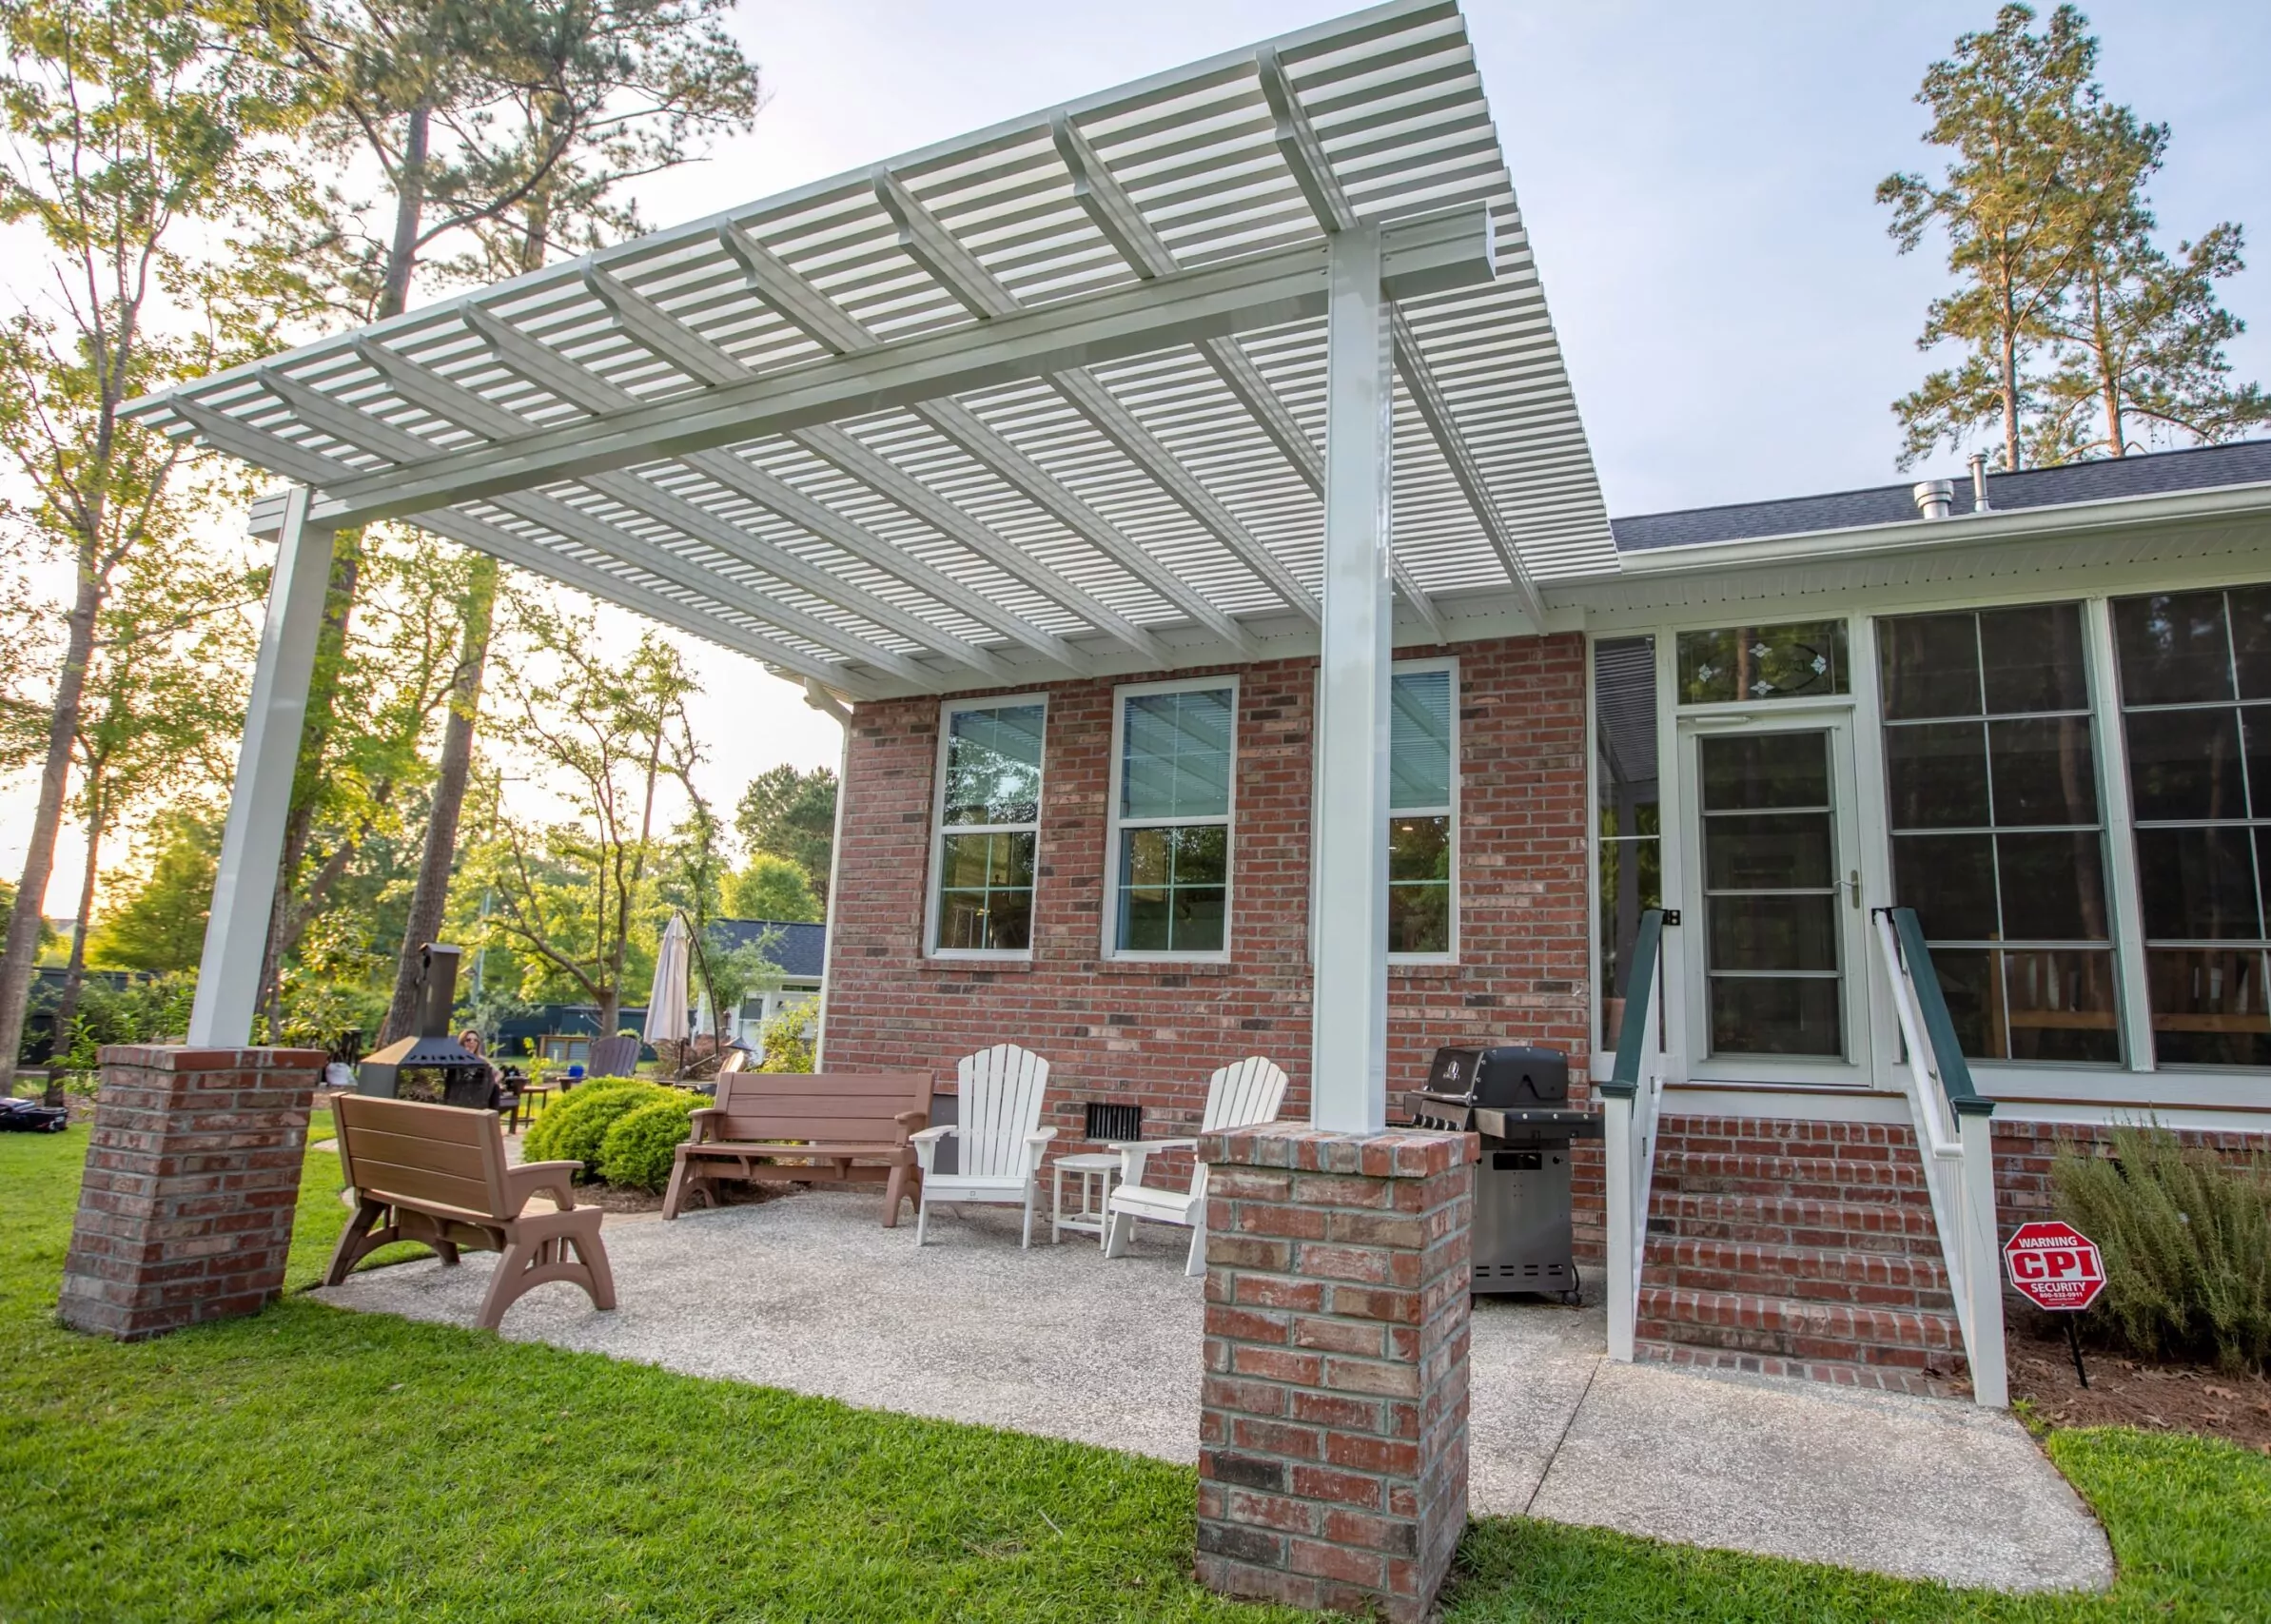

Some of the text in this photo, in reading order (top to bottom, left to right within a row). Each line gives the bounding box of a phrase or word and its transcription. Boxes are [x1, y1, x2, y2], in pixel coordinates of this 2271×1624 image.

[2018, 1237, 2078, 1248] WARNING
[2012, 1250, 2097, 1279] CPI
[2030, 1282, 2086, 1293] SECURITY
